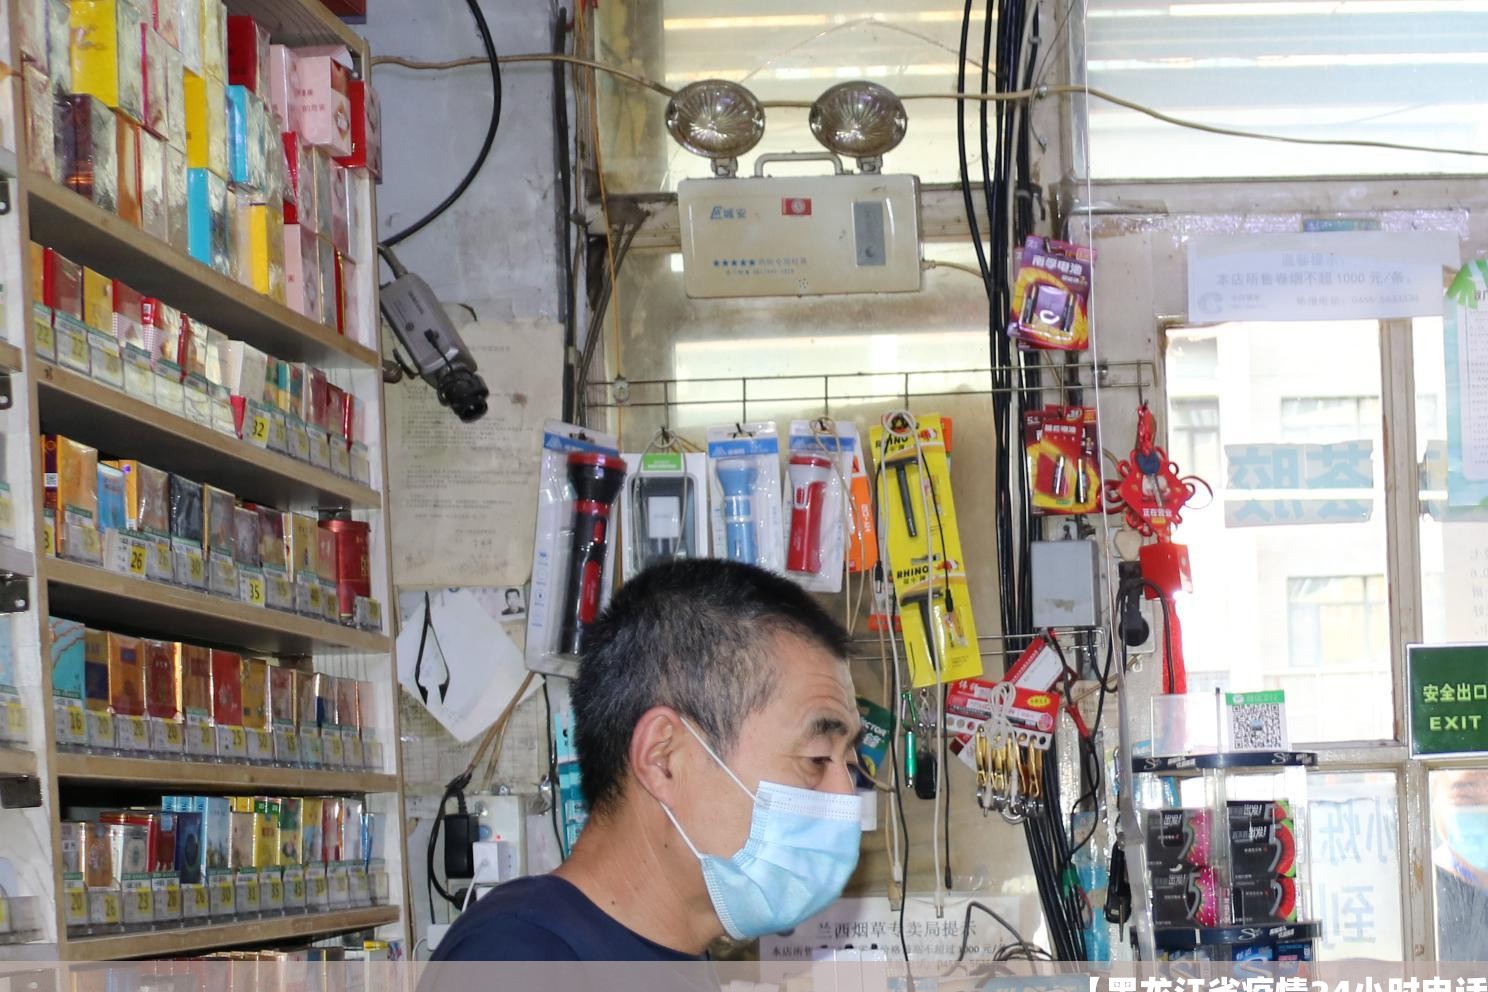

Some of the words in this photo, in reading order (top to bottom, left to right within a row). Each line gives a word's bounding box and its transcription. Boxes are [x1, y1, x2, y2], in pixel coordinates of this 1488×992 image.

[1337, 270, 1366, 285] 1000
[252, 421, 265, 438] 32
[130, 550, 143, 569] 26
[896, 566, 930, 579] RHINO
[249, 582, 261, 600] 35
[1423, 683, 1487, 703] 安全出口
[70, 711, 82, 729] 16
[1430, 715, 1481, 731] EXIT
